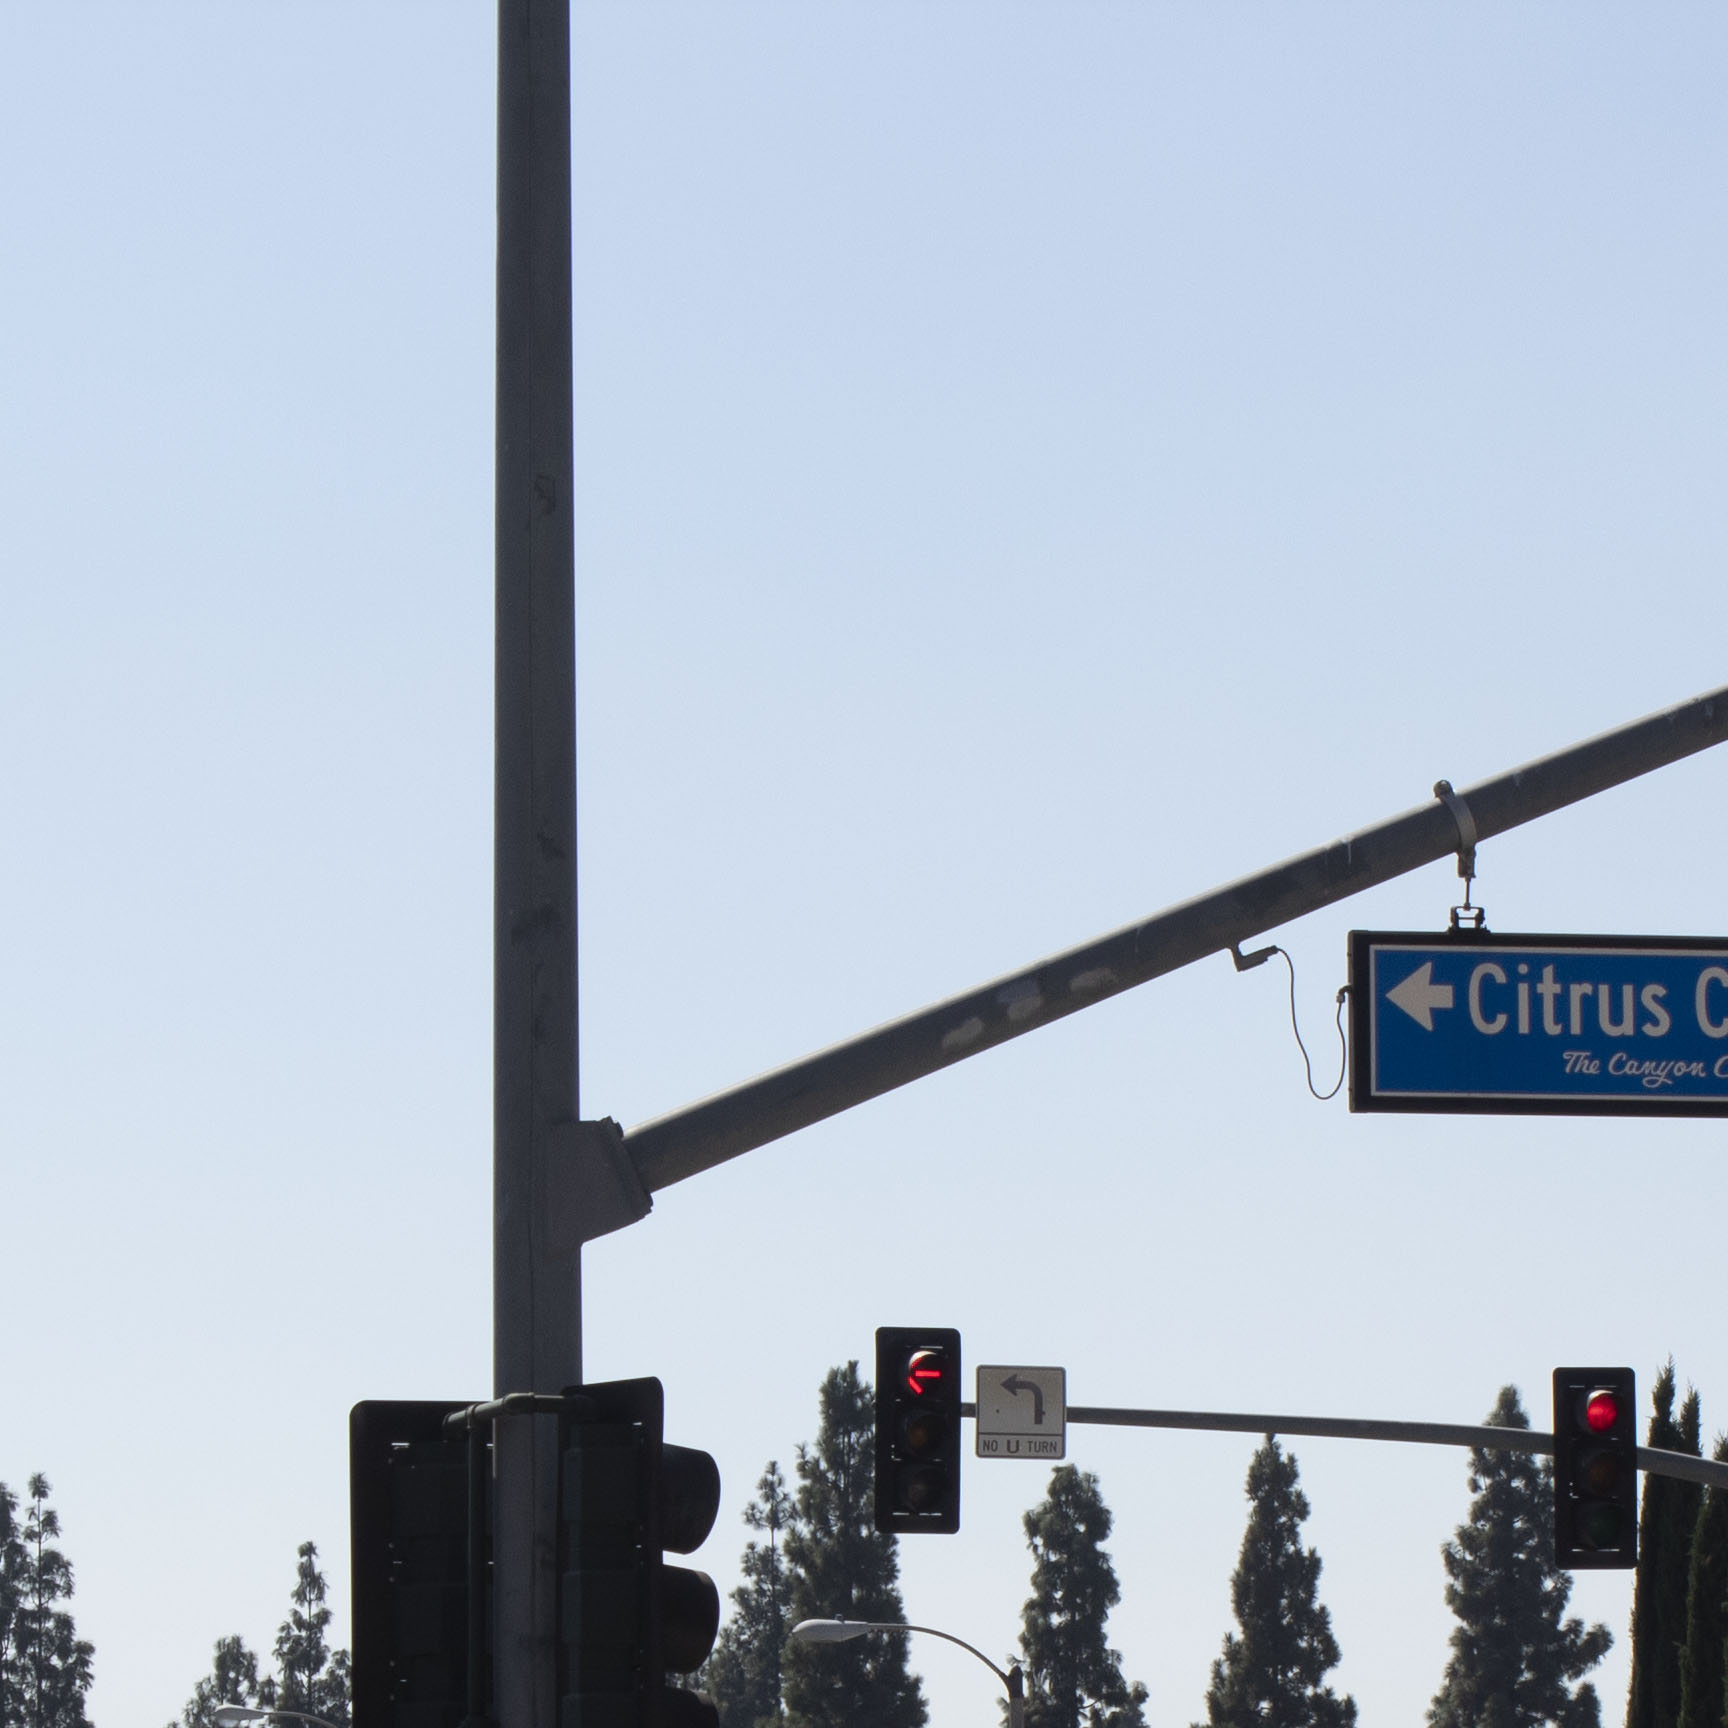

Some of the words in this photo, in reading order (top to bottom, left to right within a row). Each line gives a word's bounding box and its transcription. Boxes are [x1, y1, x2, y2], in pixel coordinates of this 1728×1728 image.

[1467, 961, 1671, 1037] Citrus
[1562, 1051, 1601, 1076] The
[1608, 1052, 1707, 1089] Canyon
[982, 1440, 998, 1452] NO
[1006, 1439, 1020, 1454] U
[1027, 1440, 1057, 1453] TURN
